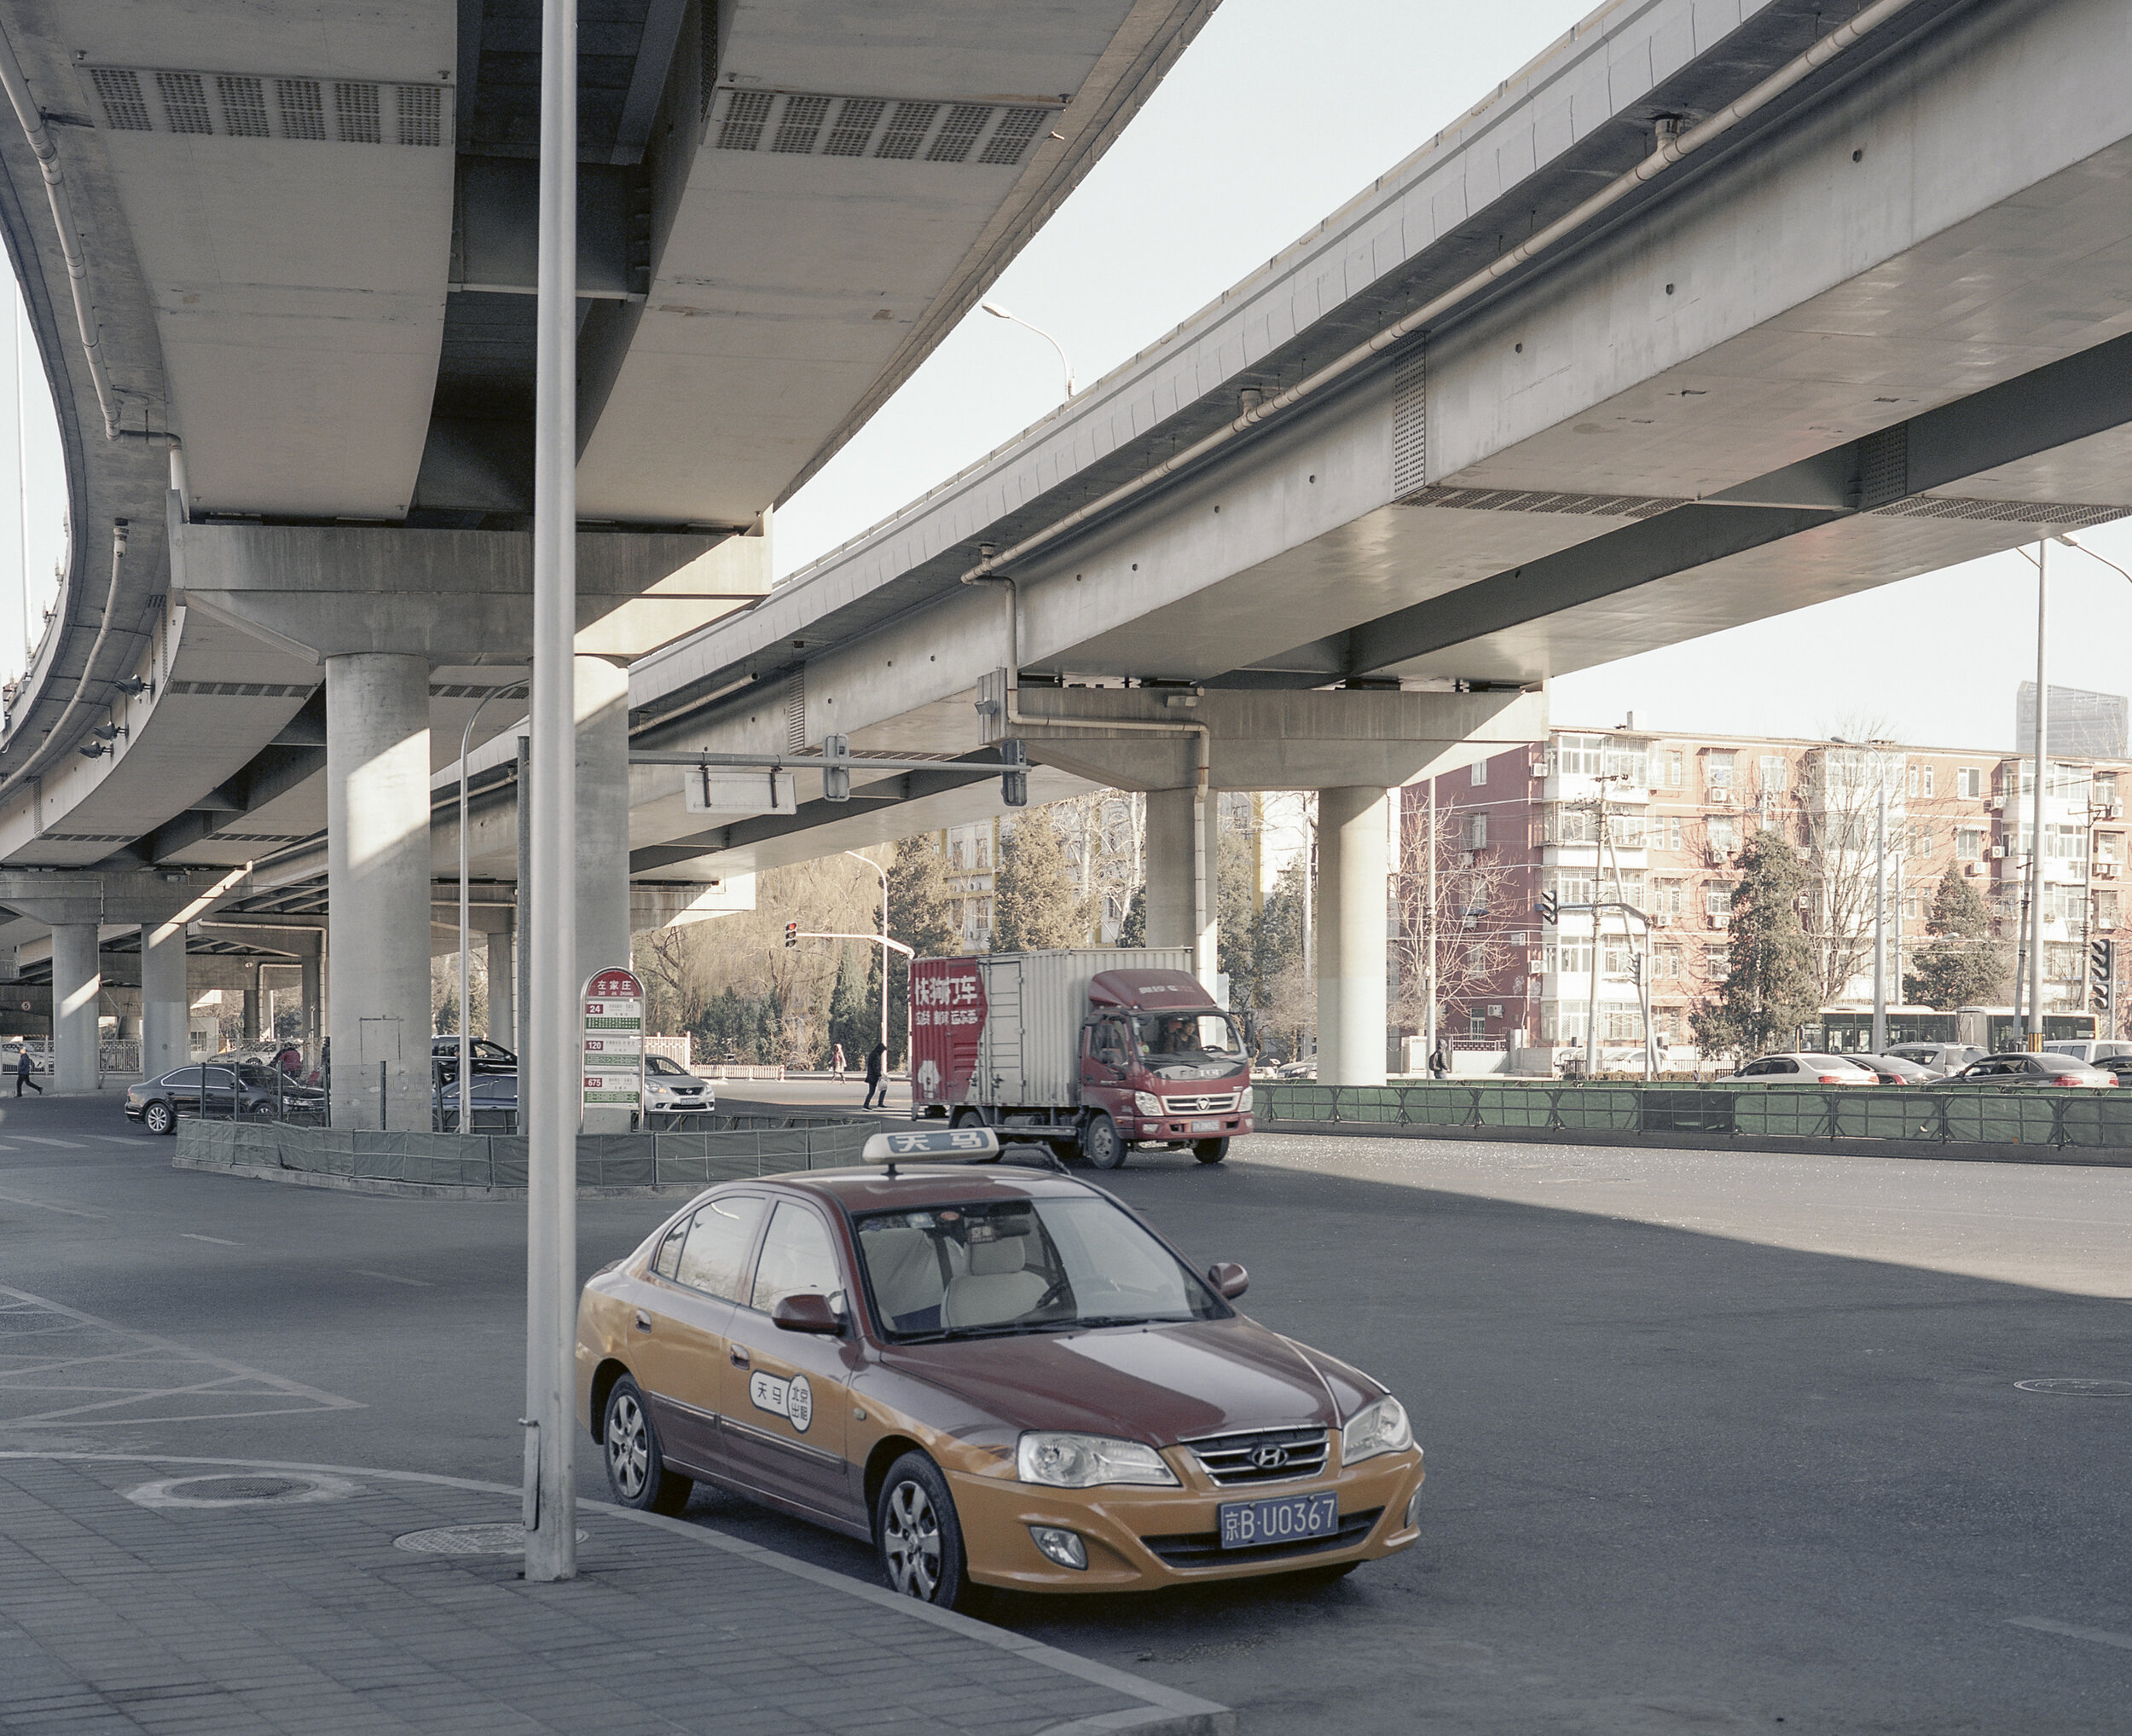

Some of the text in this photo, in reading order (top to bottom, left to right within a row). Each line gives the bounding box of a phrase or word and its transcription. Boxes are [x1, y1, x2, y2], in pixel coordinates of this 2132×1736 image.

[597, 980, 632, 990] 左家庄
[914, 975, 977, 1005] 快狗打车
[588, 1041, 601, 1050] 120
[588, 1079, 601, 1087] 675
[895, 1131, 982, 1152] 天马
[757, 1381, 781, 1404] 天马
